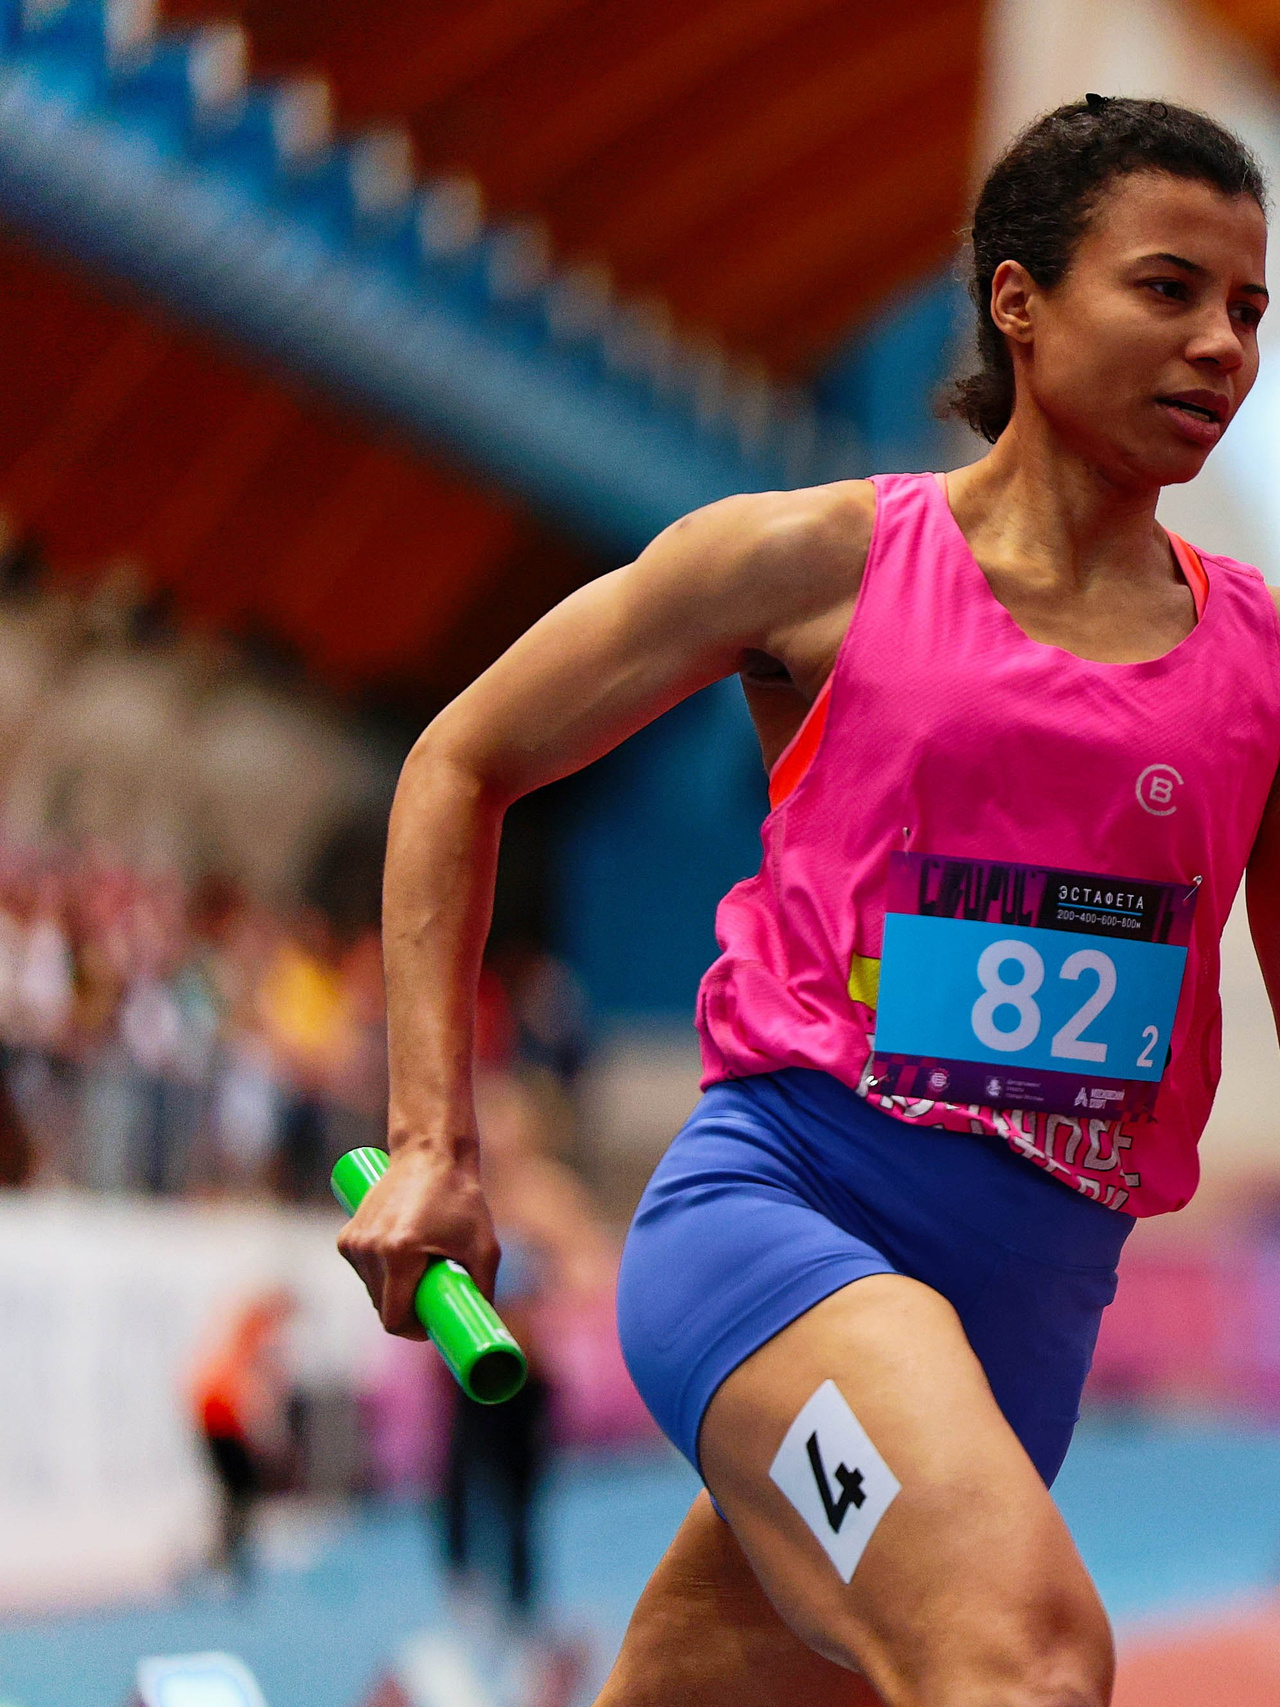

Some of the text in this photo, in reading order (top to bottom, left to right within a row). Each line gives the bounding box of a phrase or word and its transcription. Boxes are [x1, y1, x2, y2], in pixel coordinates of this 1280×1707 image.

[1058, 885, 1144, 909] ЭСТАФЕТА
[970, 938, 1118, 1064] 82
[1136, 1024, 1160, 1068] 2
[806, 1429, 867, 1535] 4
